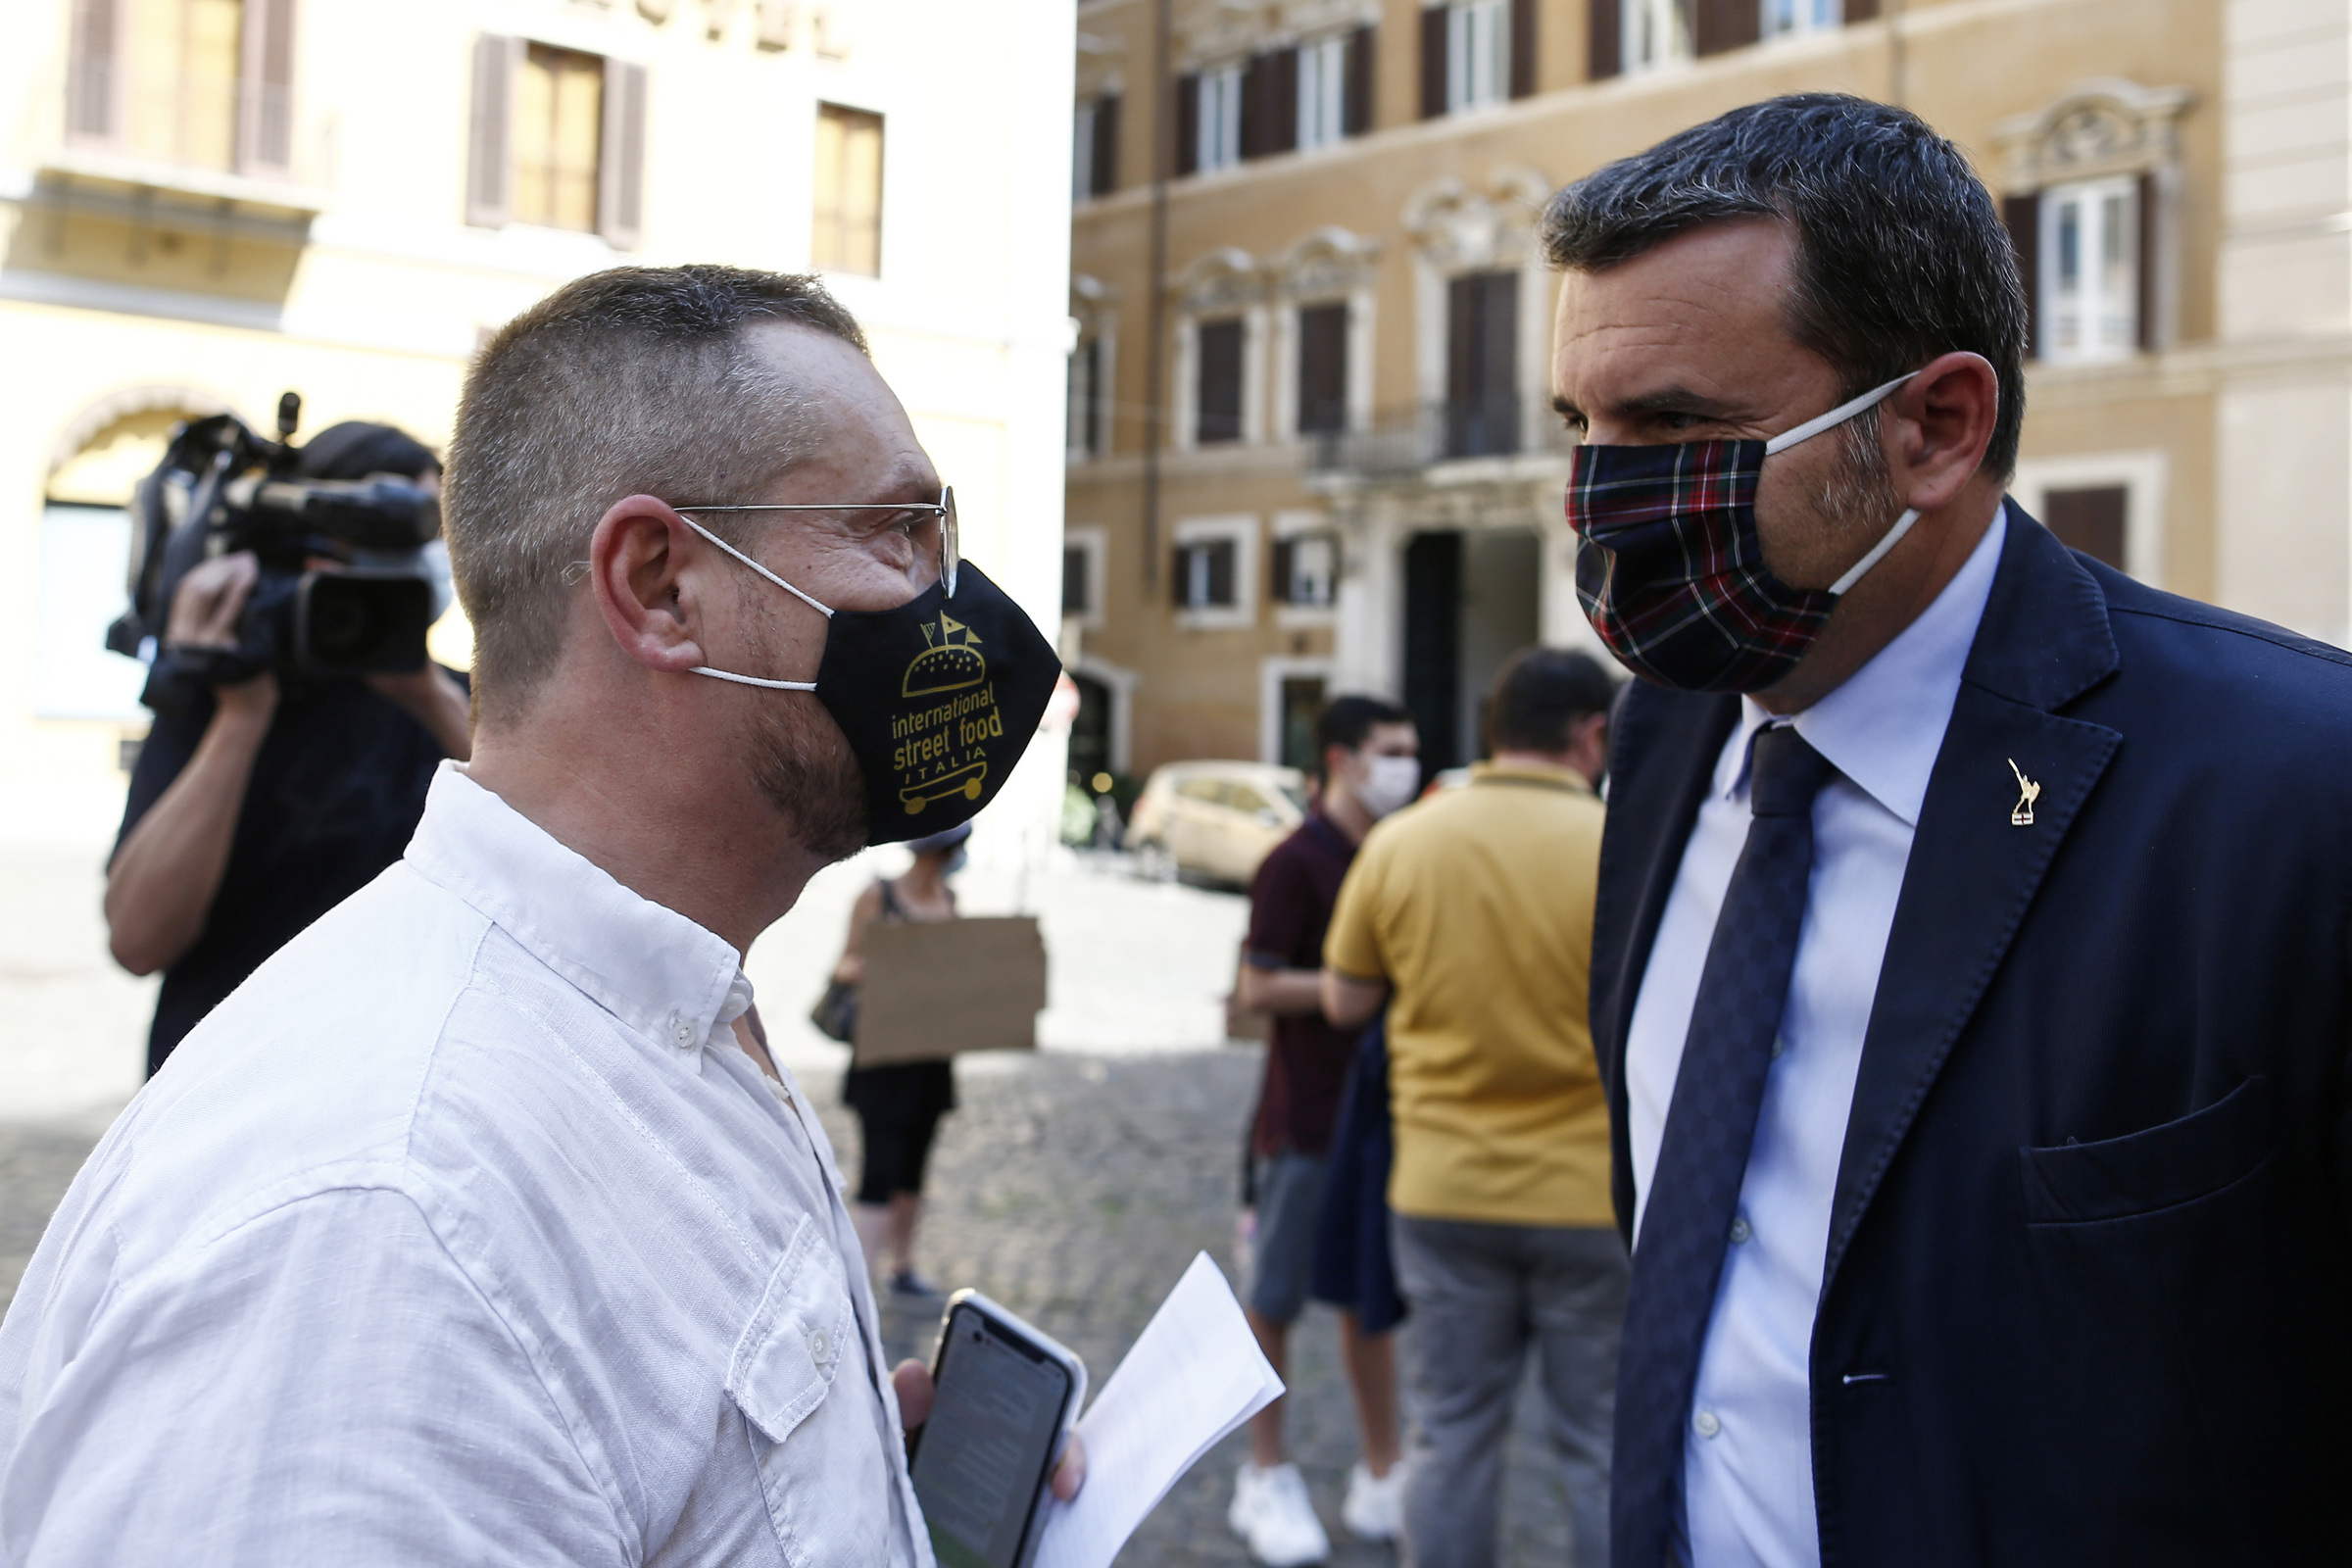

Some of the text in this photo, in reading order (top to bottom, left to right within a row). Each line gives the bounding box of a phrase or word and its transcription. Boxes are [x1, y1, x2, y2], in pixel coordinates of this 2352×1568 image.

[892, 682, 995, 739] international
[894, 707, 1004, 771] street food
[906, 747, 986, 784] ITALIA
